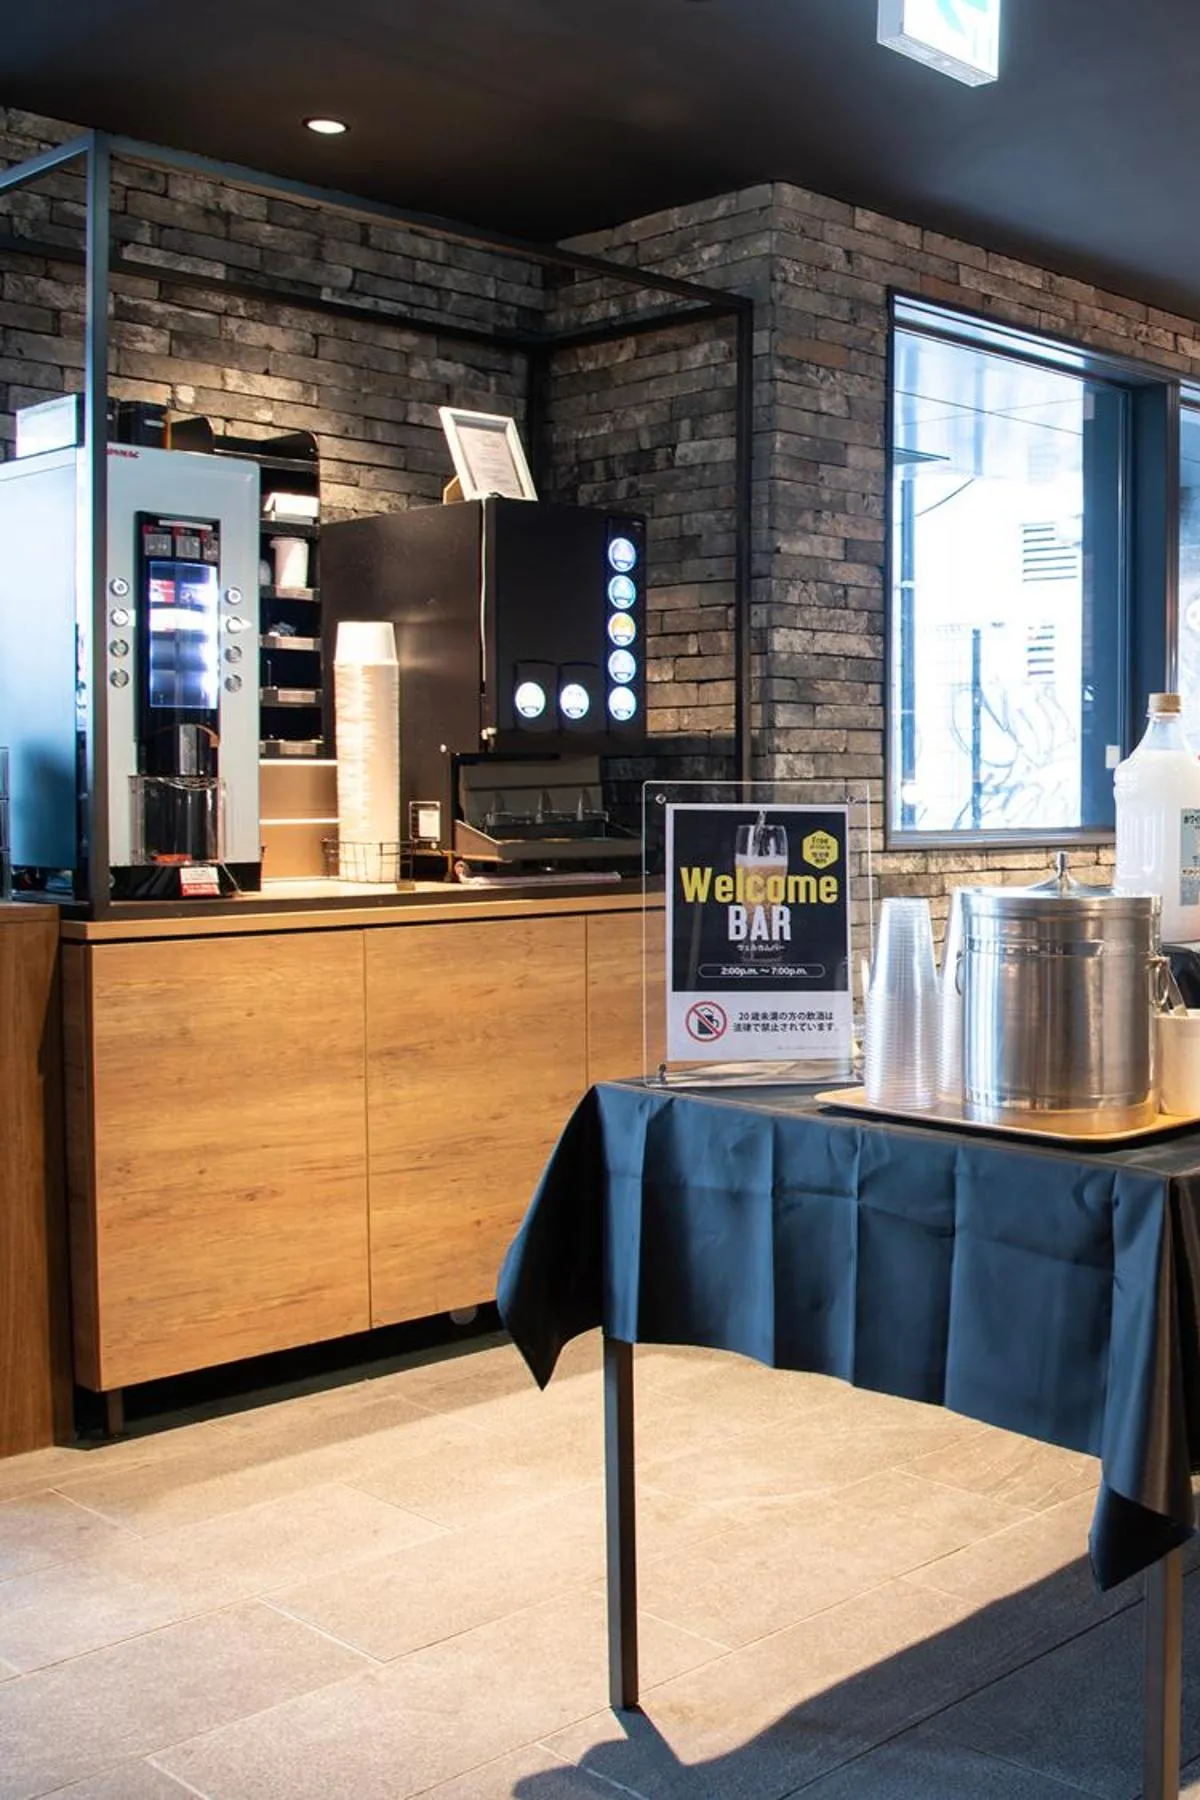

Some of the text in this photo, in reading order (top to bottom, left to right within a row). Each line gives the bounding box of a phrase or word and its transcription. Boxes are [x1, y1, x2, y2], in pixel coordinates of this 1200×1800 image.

[680, 867, 839, 904] Welcome
[728, 905, 792, 941] BAR
[721, 967, 758, 977] 2:00p.m.
[771, 967, 808, 977] 7:00p.m.
